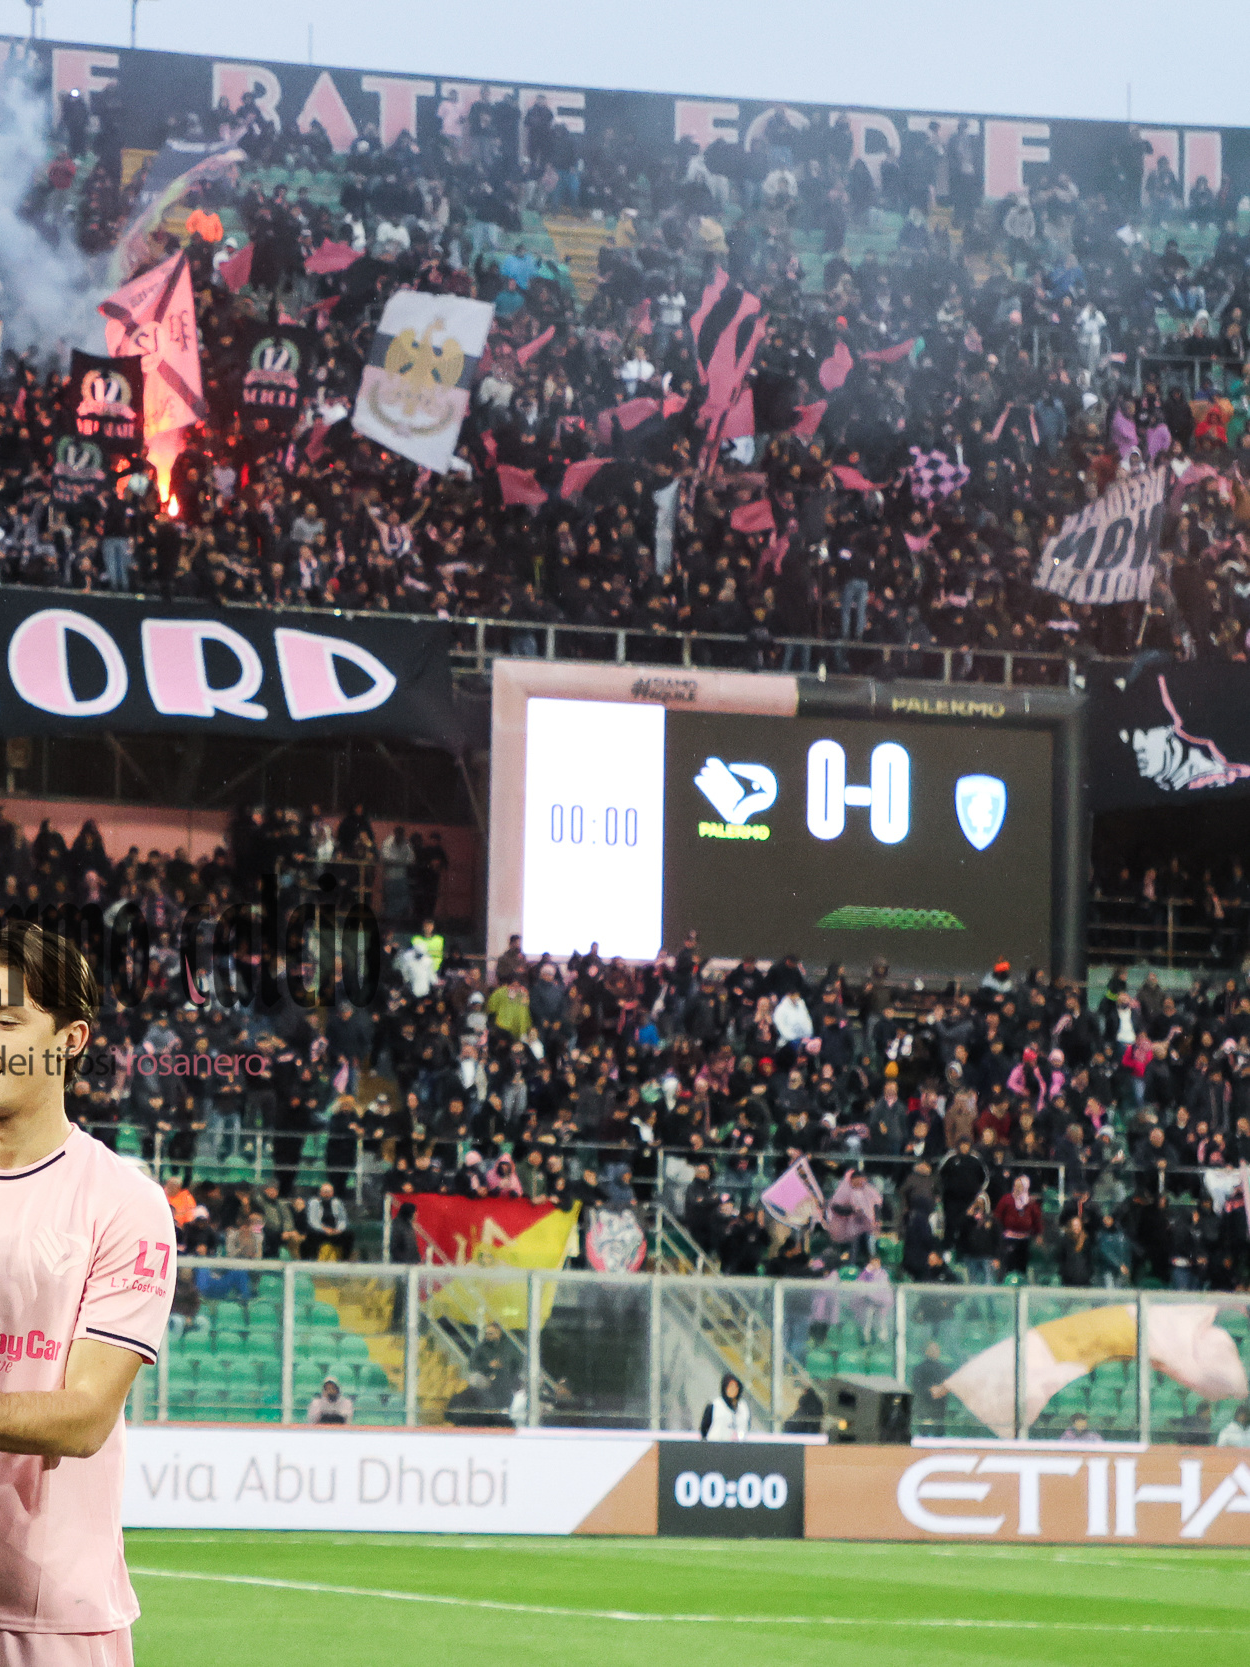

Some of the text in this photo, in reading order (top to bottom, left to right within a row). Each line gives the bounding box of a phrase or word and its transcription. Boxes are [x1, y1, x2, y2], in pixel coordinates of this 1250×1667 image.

[892, 698, 1006, 718] PALERMO
[551, 804, 638, 847] 00:00
[698, 821, 771, 841] PALERMO
[140, 1452, 510, 1507] via Abu Dhabi
[675, 1471, 787, 1509] 00:00
